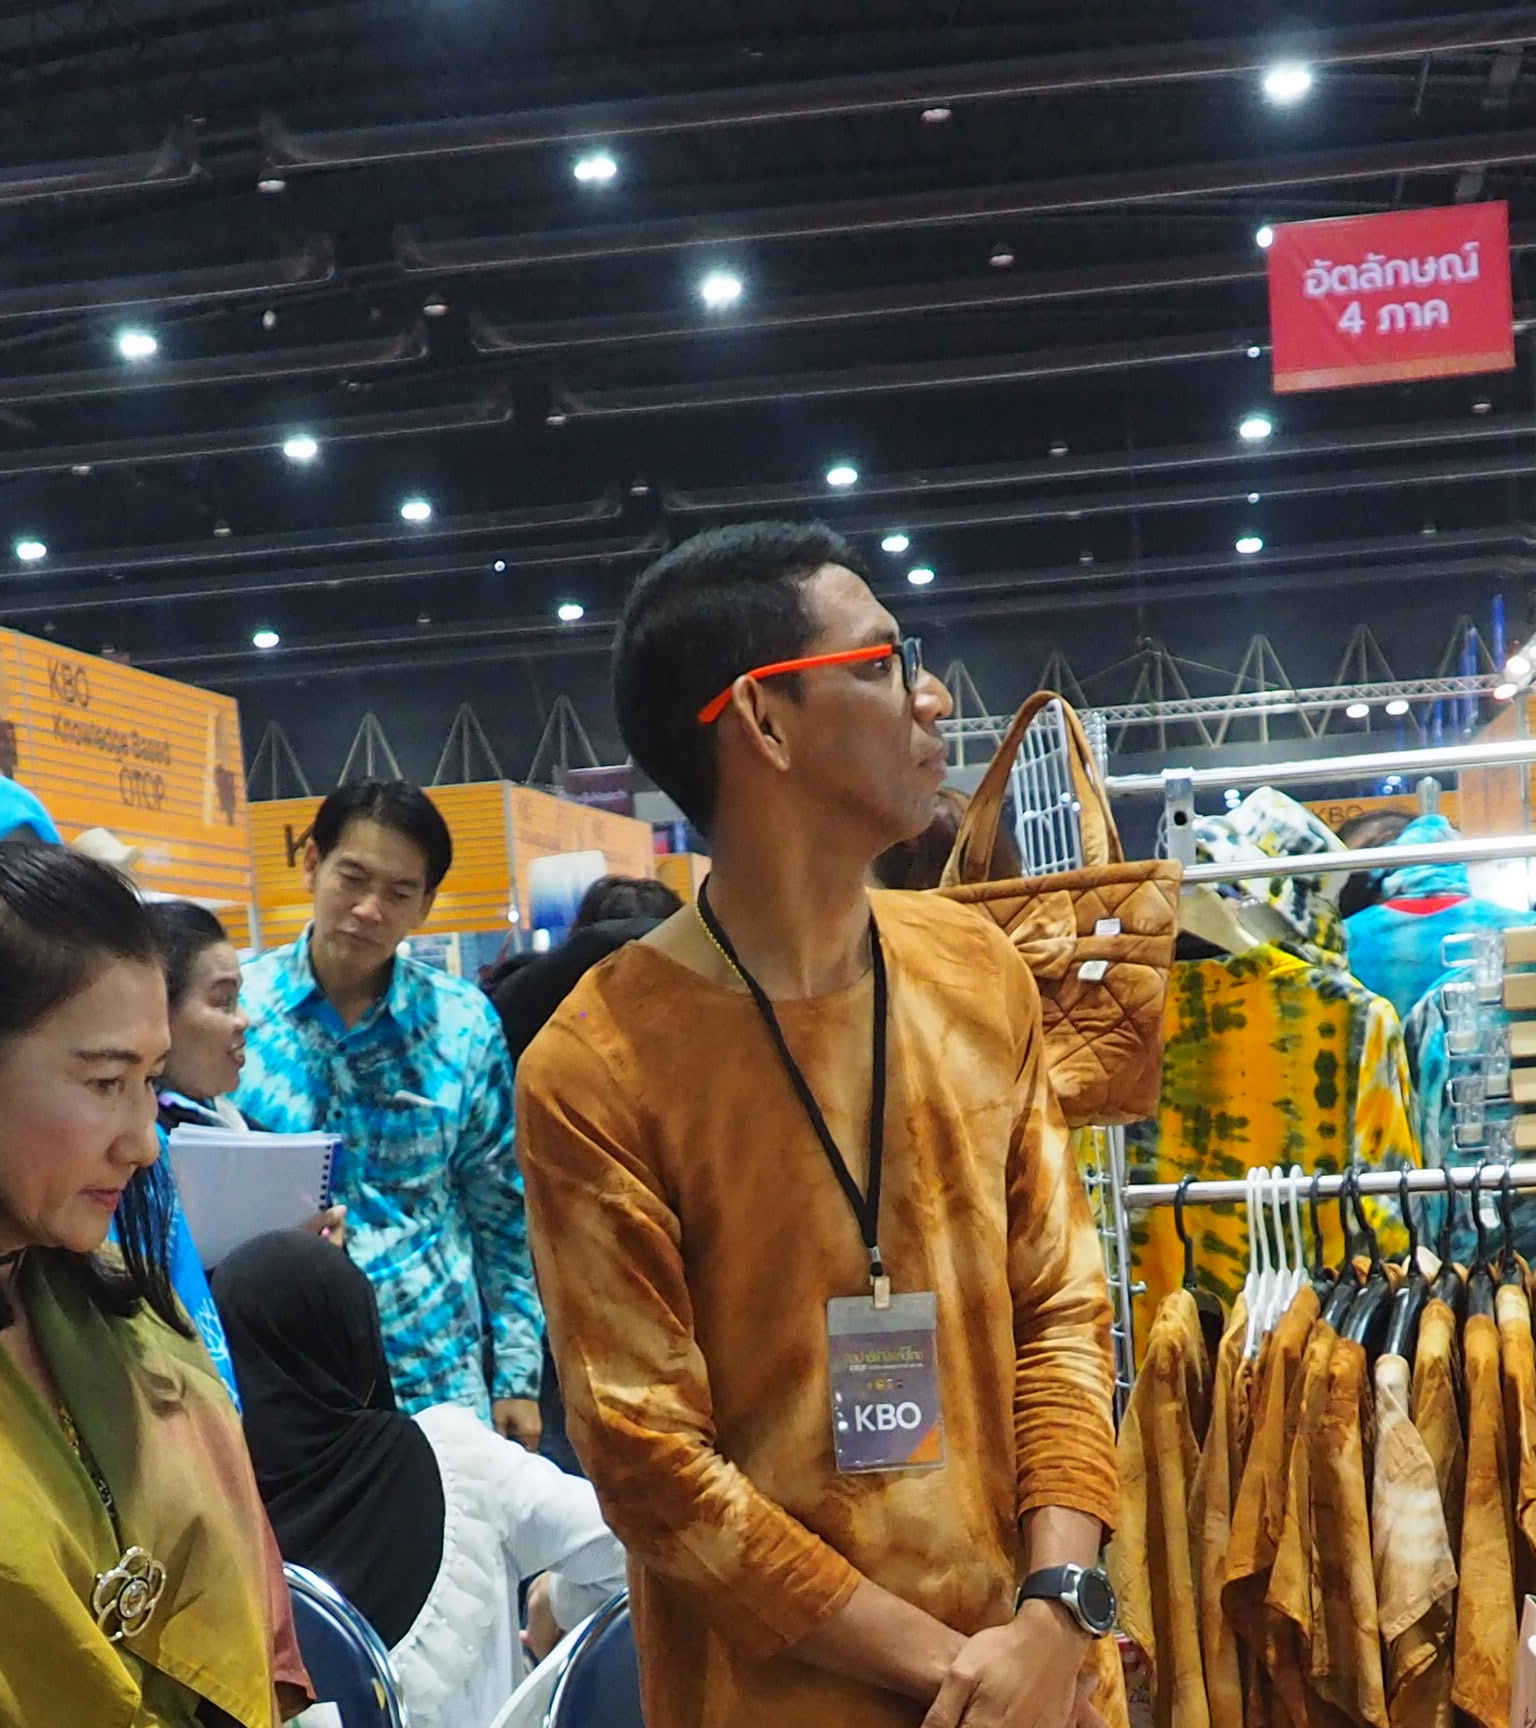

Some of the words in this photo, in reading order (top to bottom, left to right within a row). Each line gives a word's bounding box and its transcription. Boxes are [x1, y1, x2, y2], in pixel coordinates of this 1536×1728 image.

[1304, 241, 1480, 298] อัตลักษณ์
[1338, 300, 1365, 335] 4
[1376, 298, 1451, 334] ภาค
[47, 657, 89, 708] KBO
[854, 1402, 922, 1432] KBO
